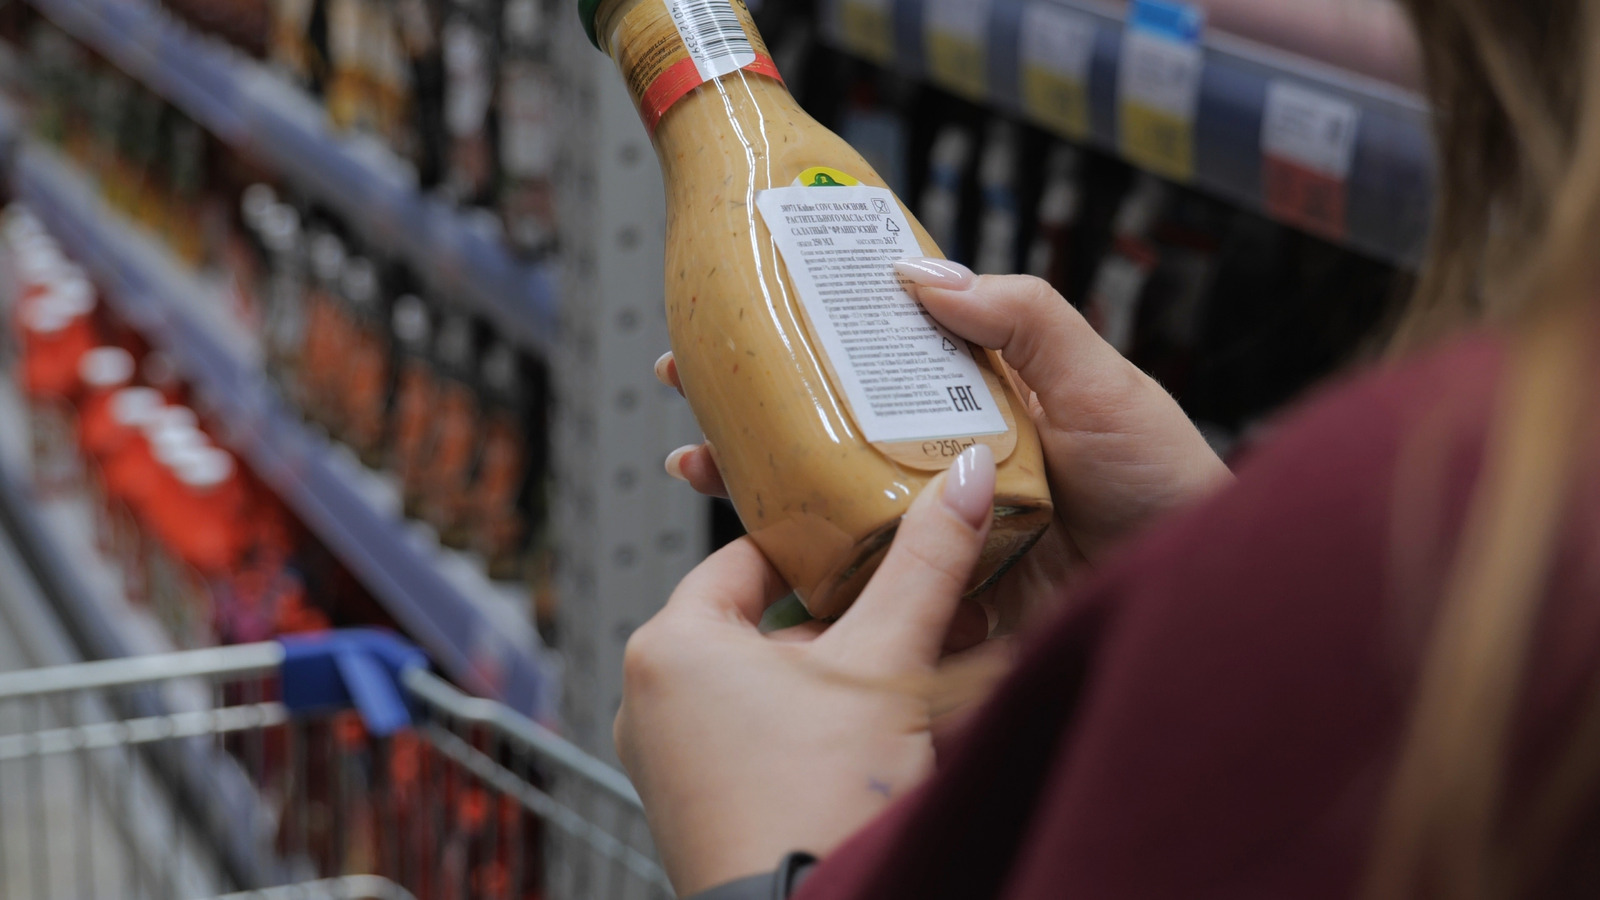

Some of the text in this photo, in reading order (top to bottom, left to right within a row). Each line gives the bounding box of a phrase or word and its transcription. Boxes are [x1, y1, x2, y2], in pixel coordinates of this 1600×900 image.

[815, 202, 833, 211] СОУС
[843, 202, 868, 211] ОСНОВЕ
[785, 214, 841, 224] РАСТИТЕЛЬНОГО
[864, 213, 882, 222] СОУС
[791, 225, 828, 236] САЛАТНЫЙ
